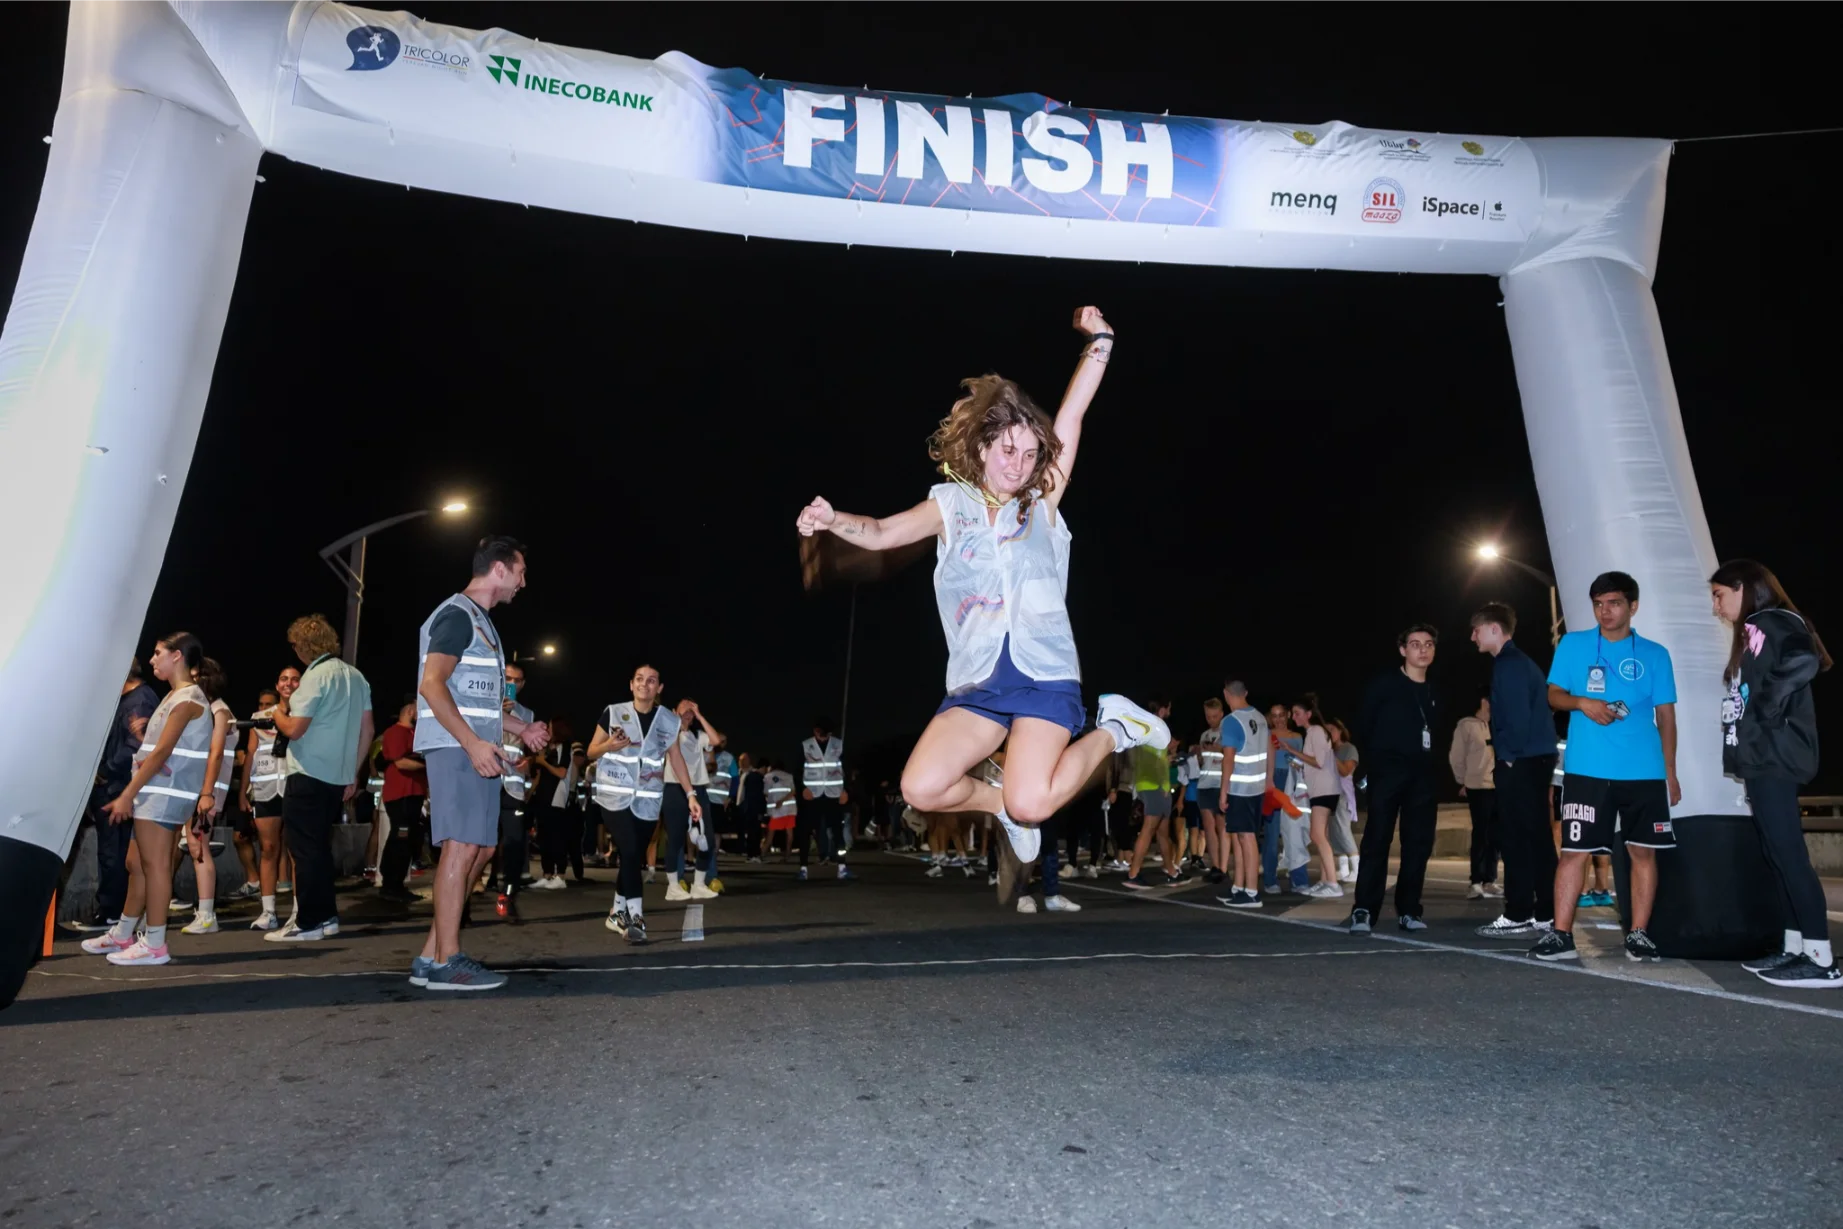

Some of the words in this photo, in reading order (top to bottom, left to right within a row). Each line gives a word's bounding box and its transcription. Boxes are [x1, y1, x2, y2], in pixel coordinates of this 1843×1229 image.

[404, 44, 470, 68] TRICOLOR
[524, 74, 654, 112] INECOBANK
[782, 88, 1174, 199] FINISH
[1270, 191, 1338, 216] menq
[1372, 192, 1396, 207] SIL
[1422, 196, 1480, 217] iSpace
[1364, 212, 1399, 221] maaza
[468, 680, 495, 691] 21010
[1562, 803, 1595, 824] CHICAGO
[1569, 820, 1582, 842] 8
